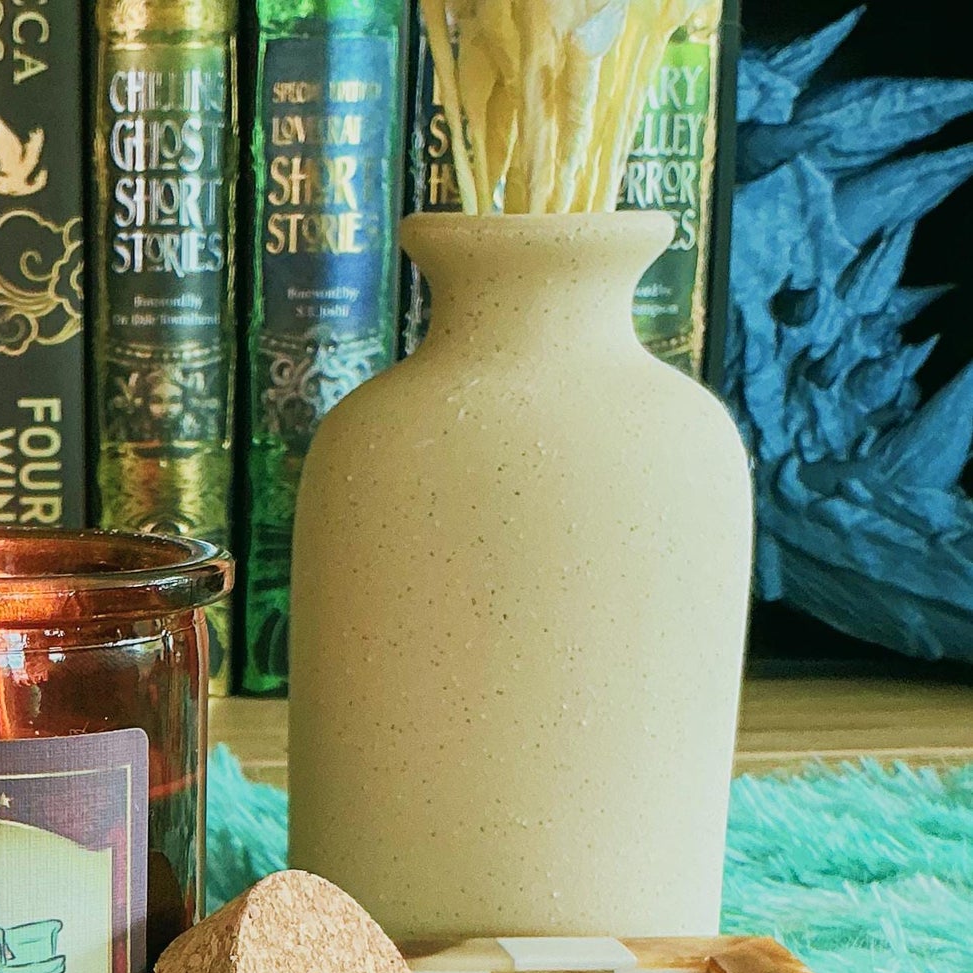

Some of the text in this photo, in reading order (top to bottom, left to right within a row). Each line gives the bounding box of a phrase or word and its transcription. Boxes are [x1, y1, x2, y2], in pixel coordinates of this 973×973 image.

[12, 0, 49, 84] CA
[110, 115, 224, 172] GHOST
[630, 111, 705, 157] LLEY
[112, 177, 224, 232] SHORT
[626, 161, 697, 209] RROR
[112, 232, 225, 278] STORIES
[16, 398, 63, 530] FOUR
